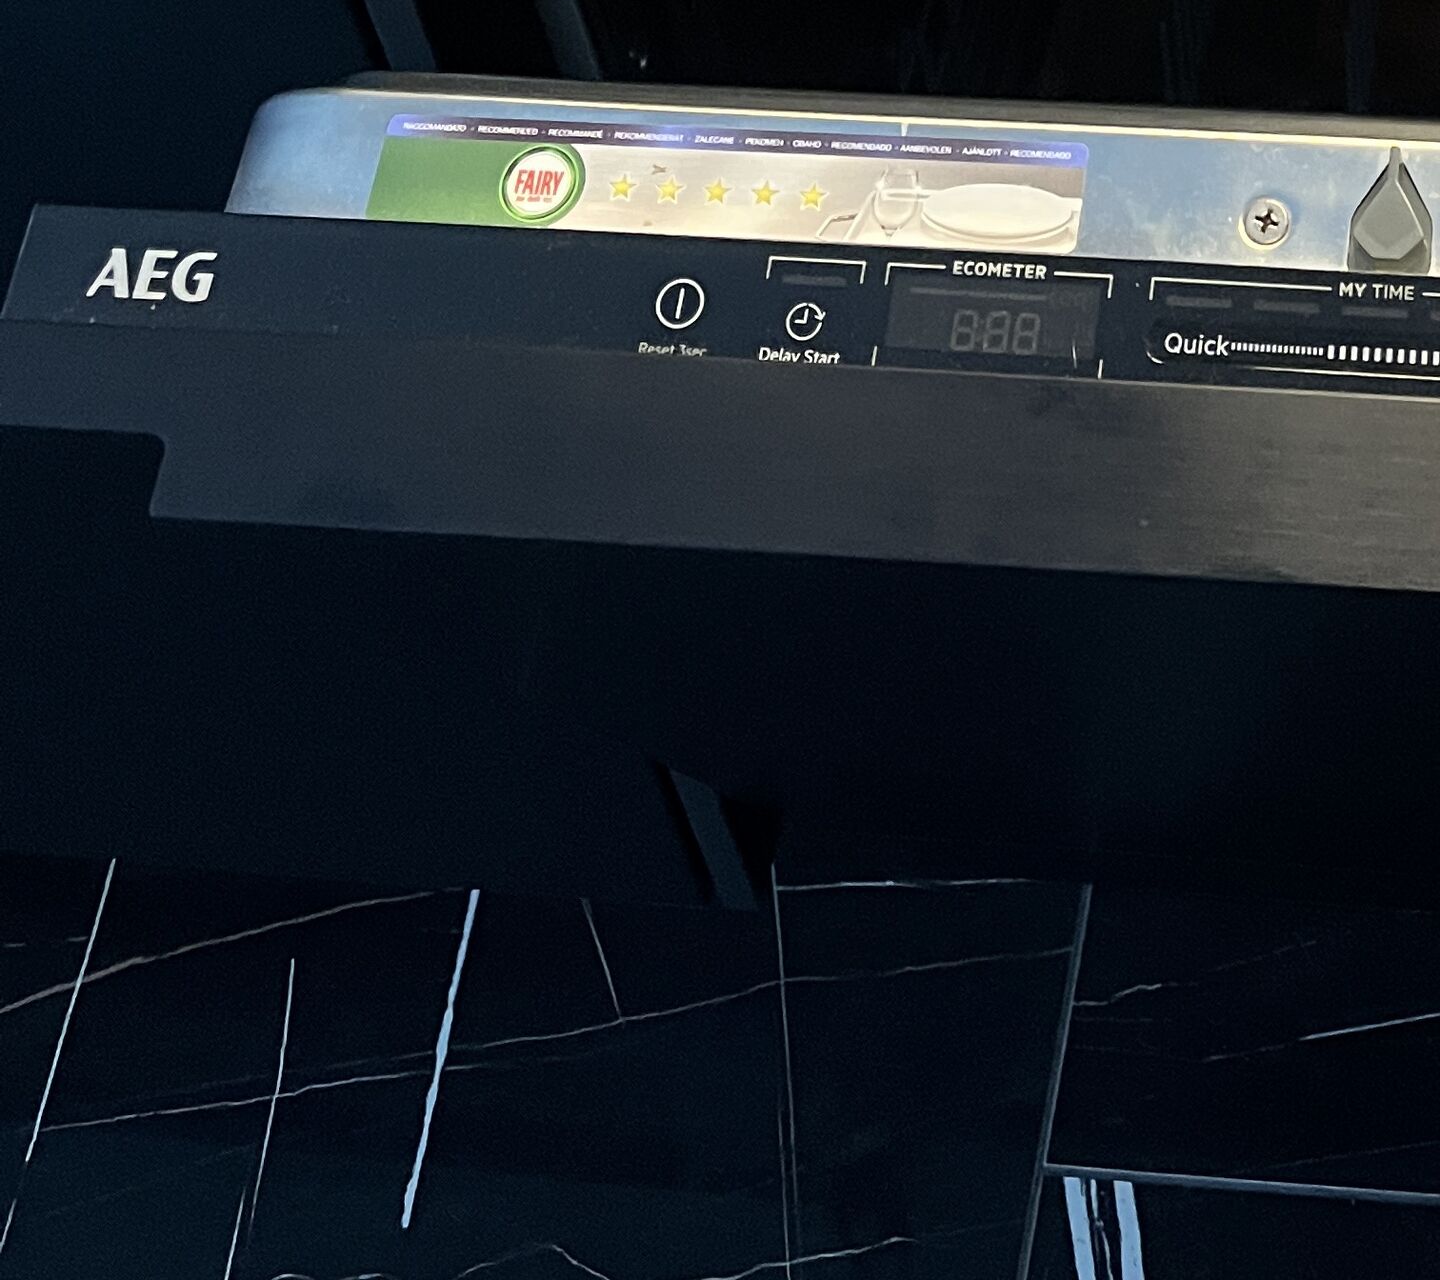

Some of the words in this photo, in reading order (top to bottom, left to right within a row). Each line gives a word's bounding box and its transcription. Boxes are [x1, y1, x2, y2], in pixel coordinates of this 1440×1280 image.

[514, 169, 565, 196] FAIRY
[85, 247, 218, 303] AEG
[952, 260, 1048, 280] ECOMETER
[1339, 283, 1367, 299] MY
[1373, 284, 1415, 301] TIME
[1164, 333, 1229, 358] Quick
[803, 349, 841, 365] Start
